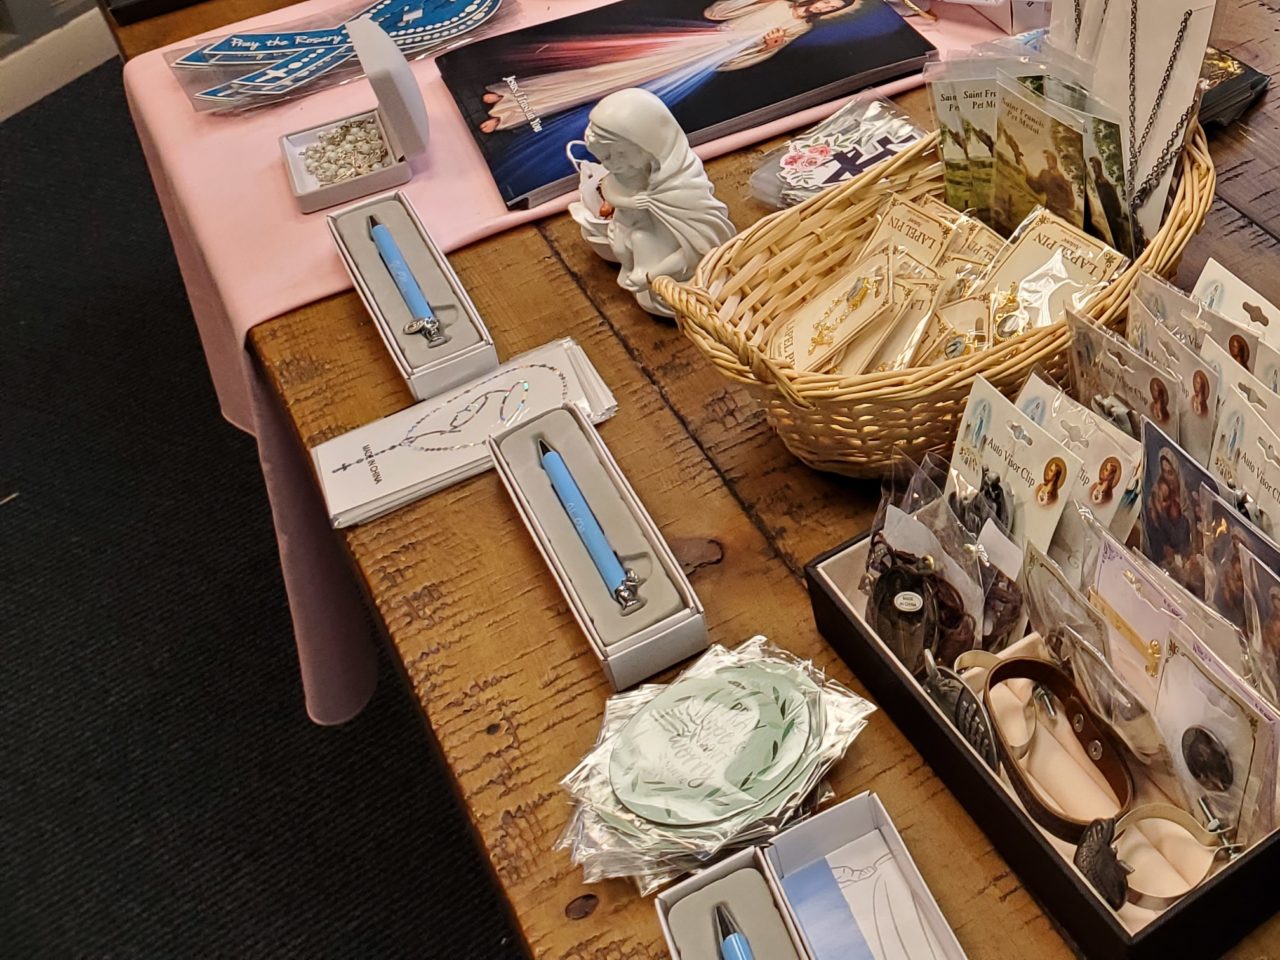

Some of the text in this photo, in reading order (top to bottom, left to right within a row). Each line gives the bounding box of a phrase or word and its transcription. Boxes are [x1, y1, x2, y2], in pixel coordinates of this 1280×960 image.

[231, 35, 343, 50] Pray the Rosary
[963, 90, 983, 99] Saint
[972, 101, 984, 110] Pet
[1001, 96, 1045, 129] Saint Francis
[530, 118, 543, 133] You
[1007, 110, 1018, 122] Pet
[888, 215, 907, 234] PIN
[905, 225, 937, 250] LAPEL
[1033, 232, 1054, 250] PIN
[1056, 243, 1099, 275] LAPEL
[362, 443, 374, 460] MADE
[370, 465, 383, 485] CHINA
[988, 437, 1036, 488] Auto Visor Clip
[1241, 451, 1255, 473] Auto
[1256, 468, 1272, 492] Visor
